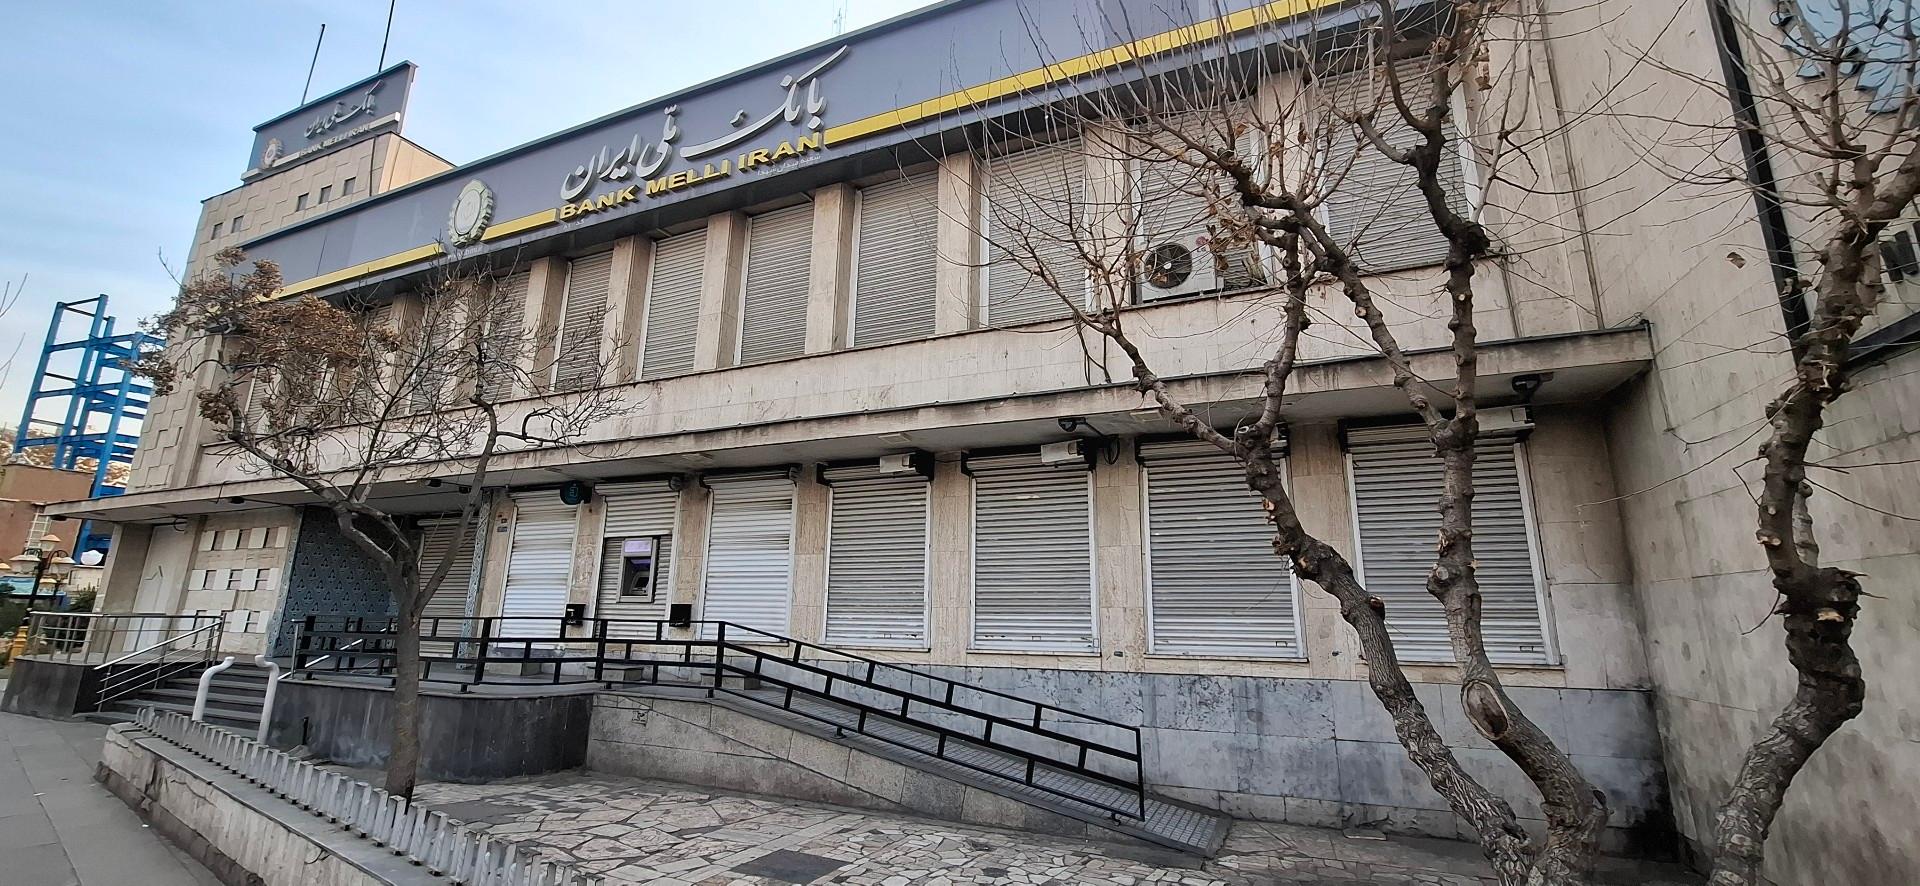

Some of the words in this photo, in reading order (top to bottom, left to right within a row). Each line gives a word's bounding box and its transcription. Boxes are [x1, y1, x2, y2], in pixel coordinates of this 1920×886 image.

[680, 44, 849, 159] بانک
[559, 184, 640, 220] BANK
[645, 158, 732, 197] MELLI
[738, 131, 823, 172] IRAN
[560, 133, 643, 200] ایران
